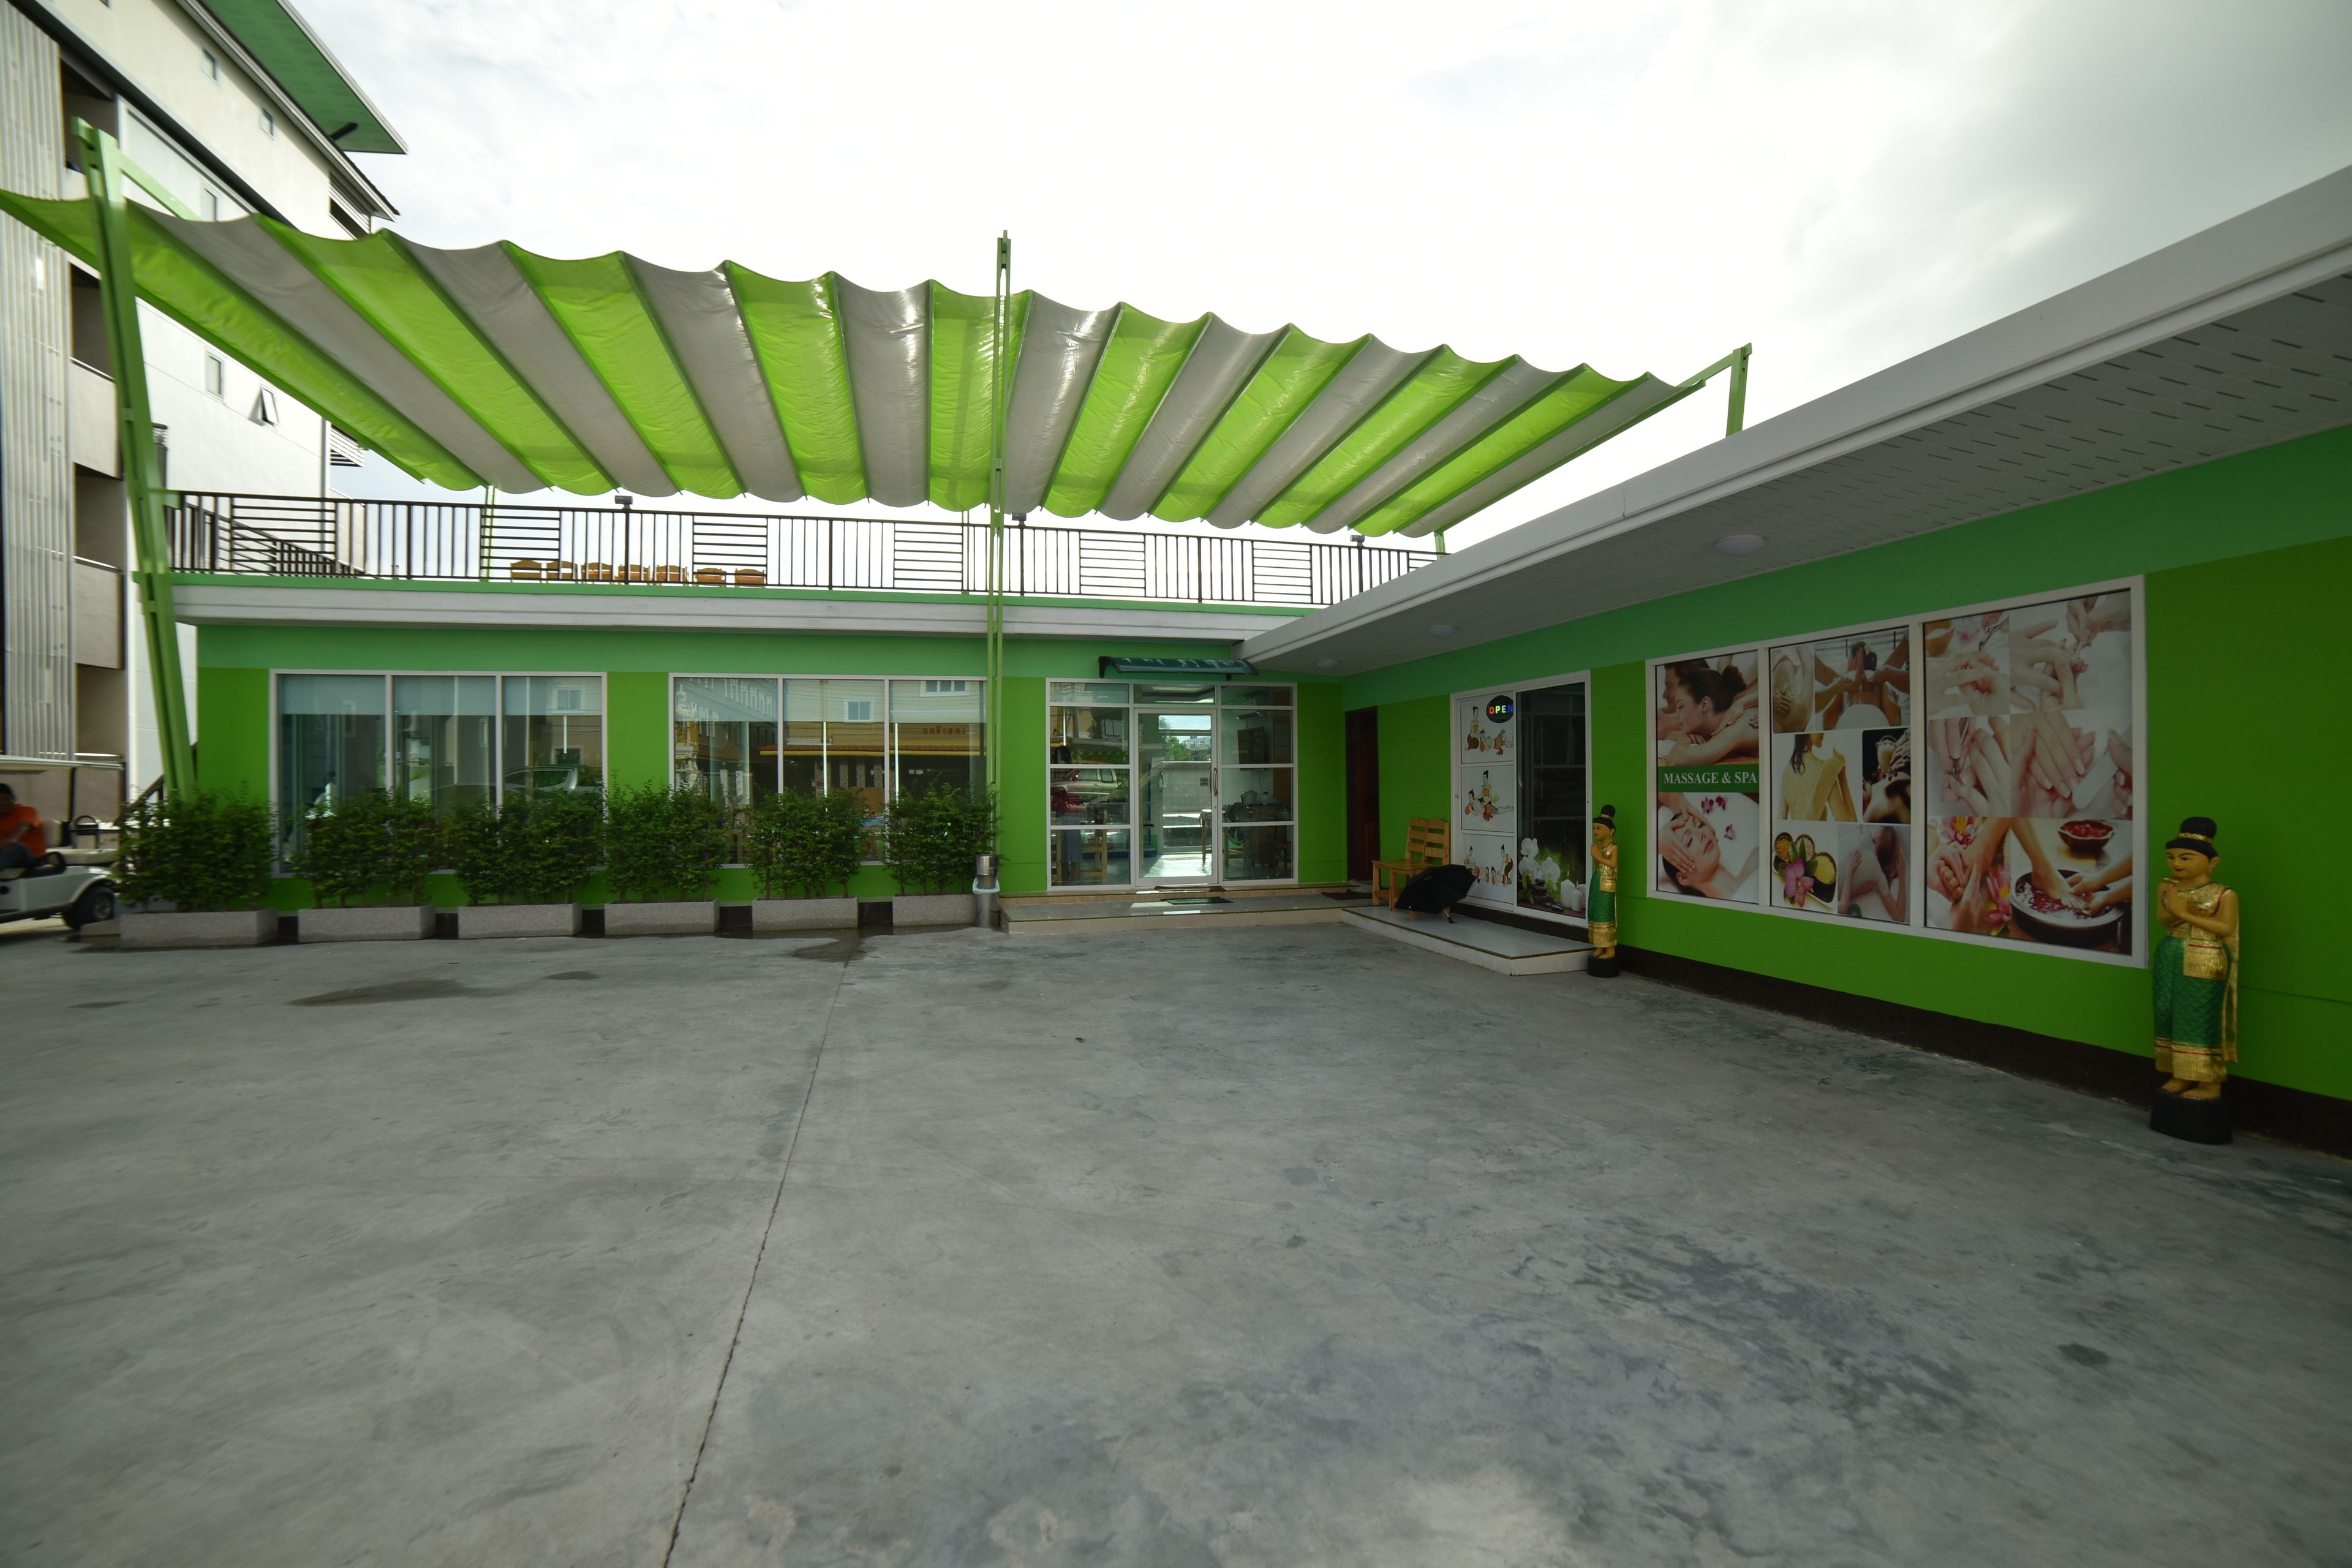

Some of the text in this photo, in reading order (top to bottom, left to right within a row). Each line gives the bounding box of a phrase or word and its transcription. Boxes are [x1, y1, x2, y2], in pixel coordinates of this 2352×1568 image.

[1489, 704, 1513, 715] OPEN
[1664, 771, 1757, 784] MASSAGE & SPA
